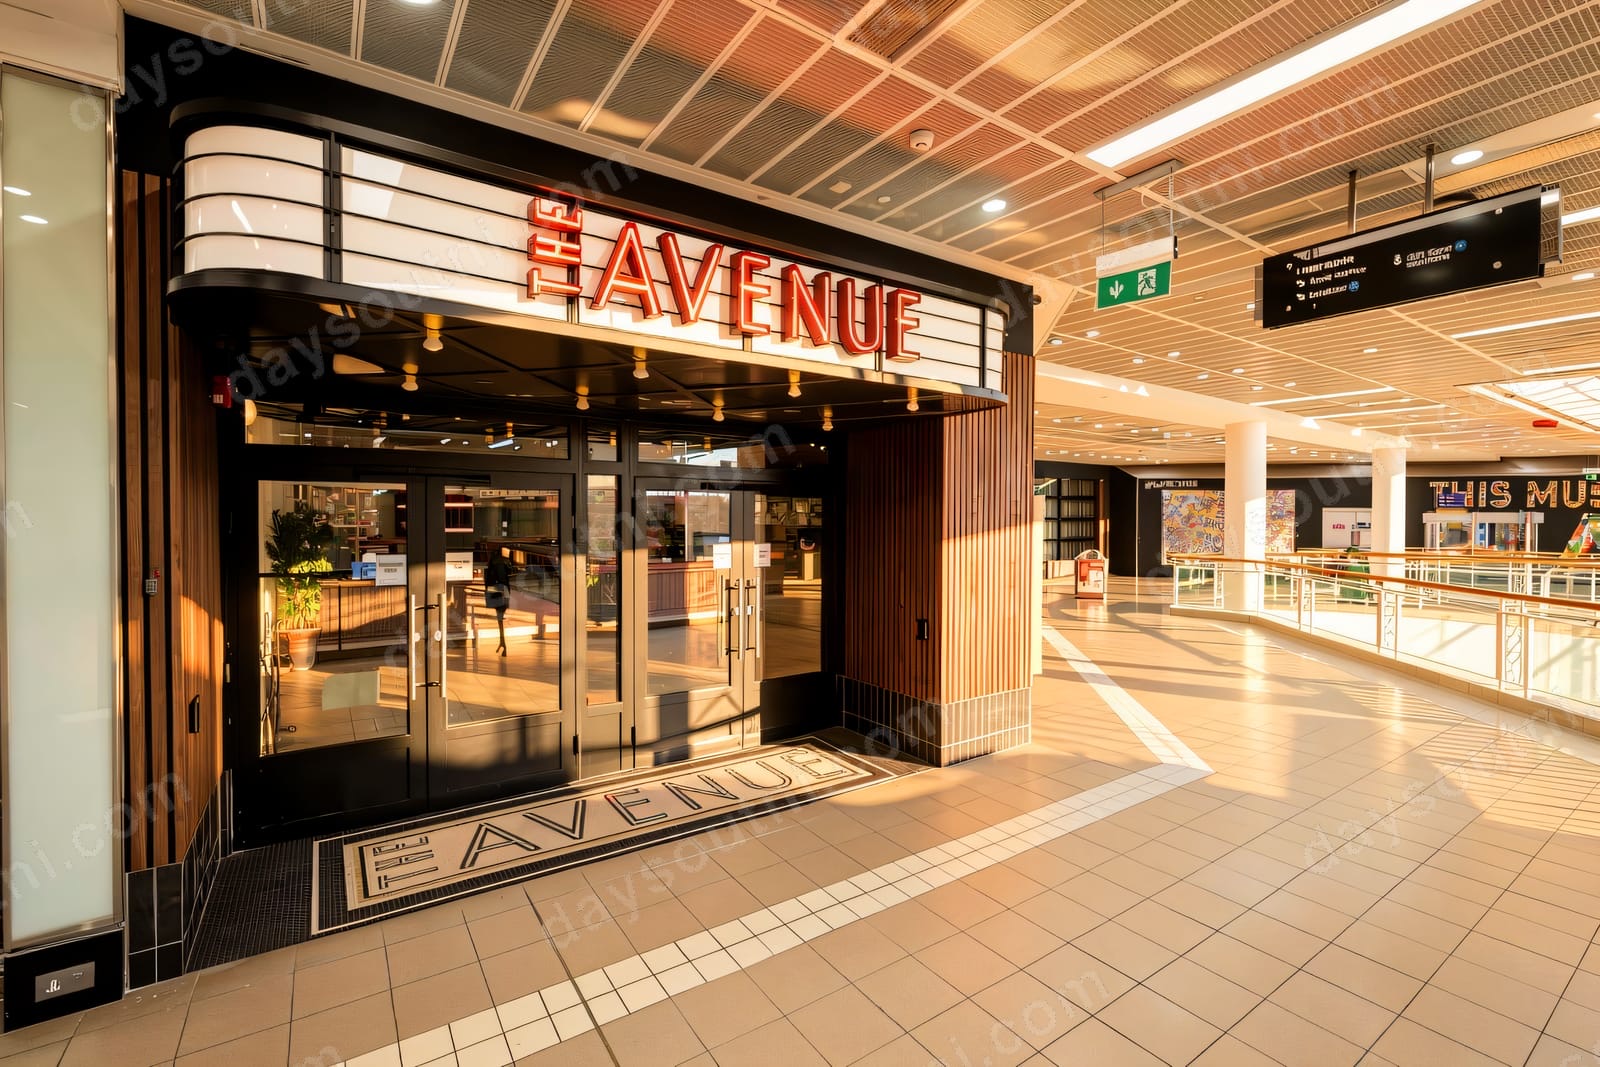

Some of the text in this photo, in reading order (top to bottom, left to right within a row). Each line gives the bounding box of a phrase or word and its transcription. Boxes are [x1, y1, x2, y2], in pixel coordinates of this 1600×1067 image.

[527, 196, 922, 362] THE AVENUE
[1429, 480, 1512, 508] THIS
[372, 747, 847, 890] THE AVENUE
